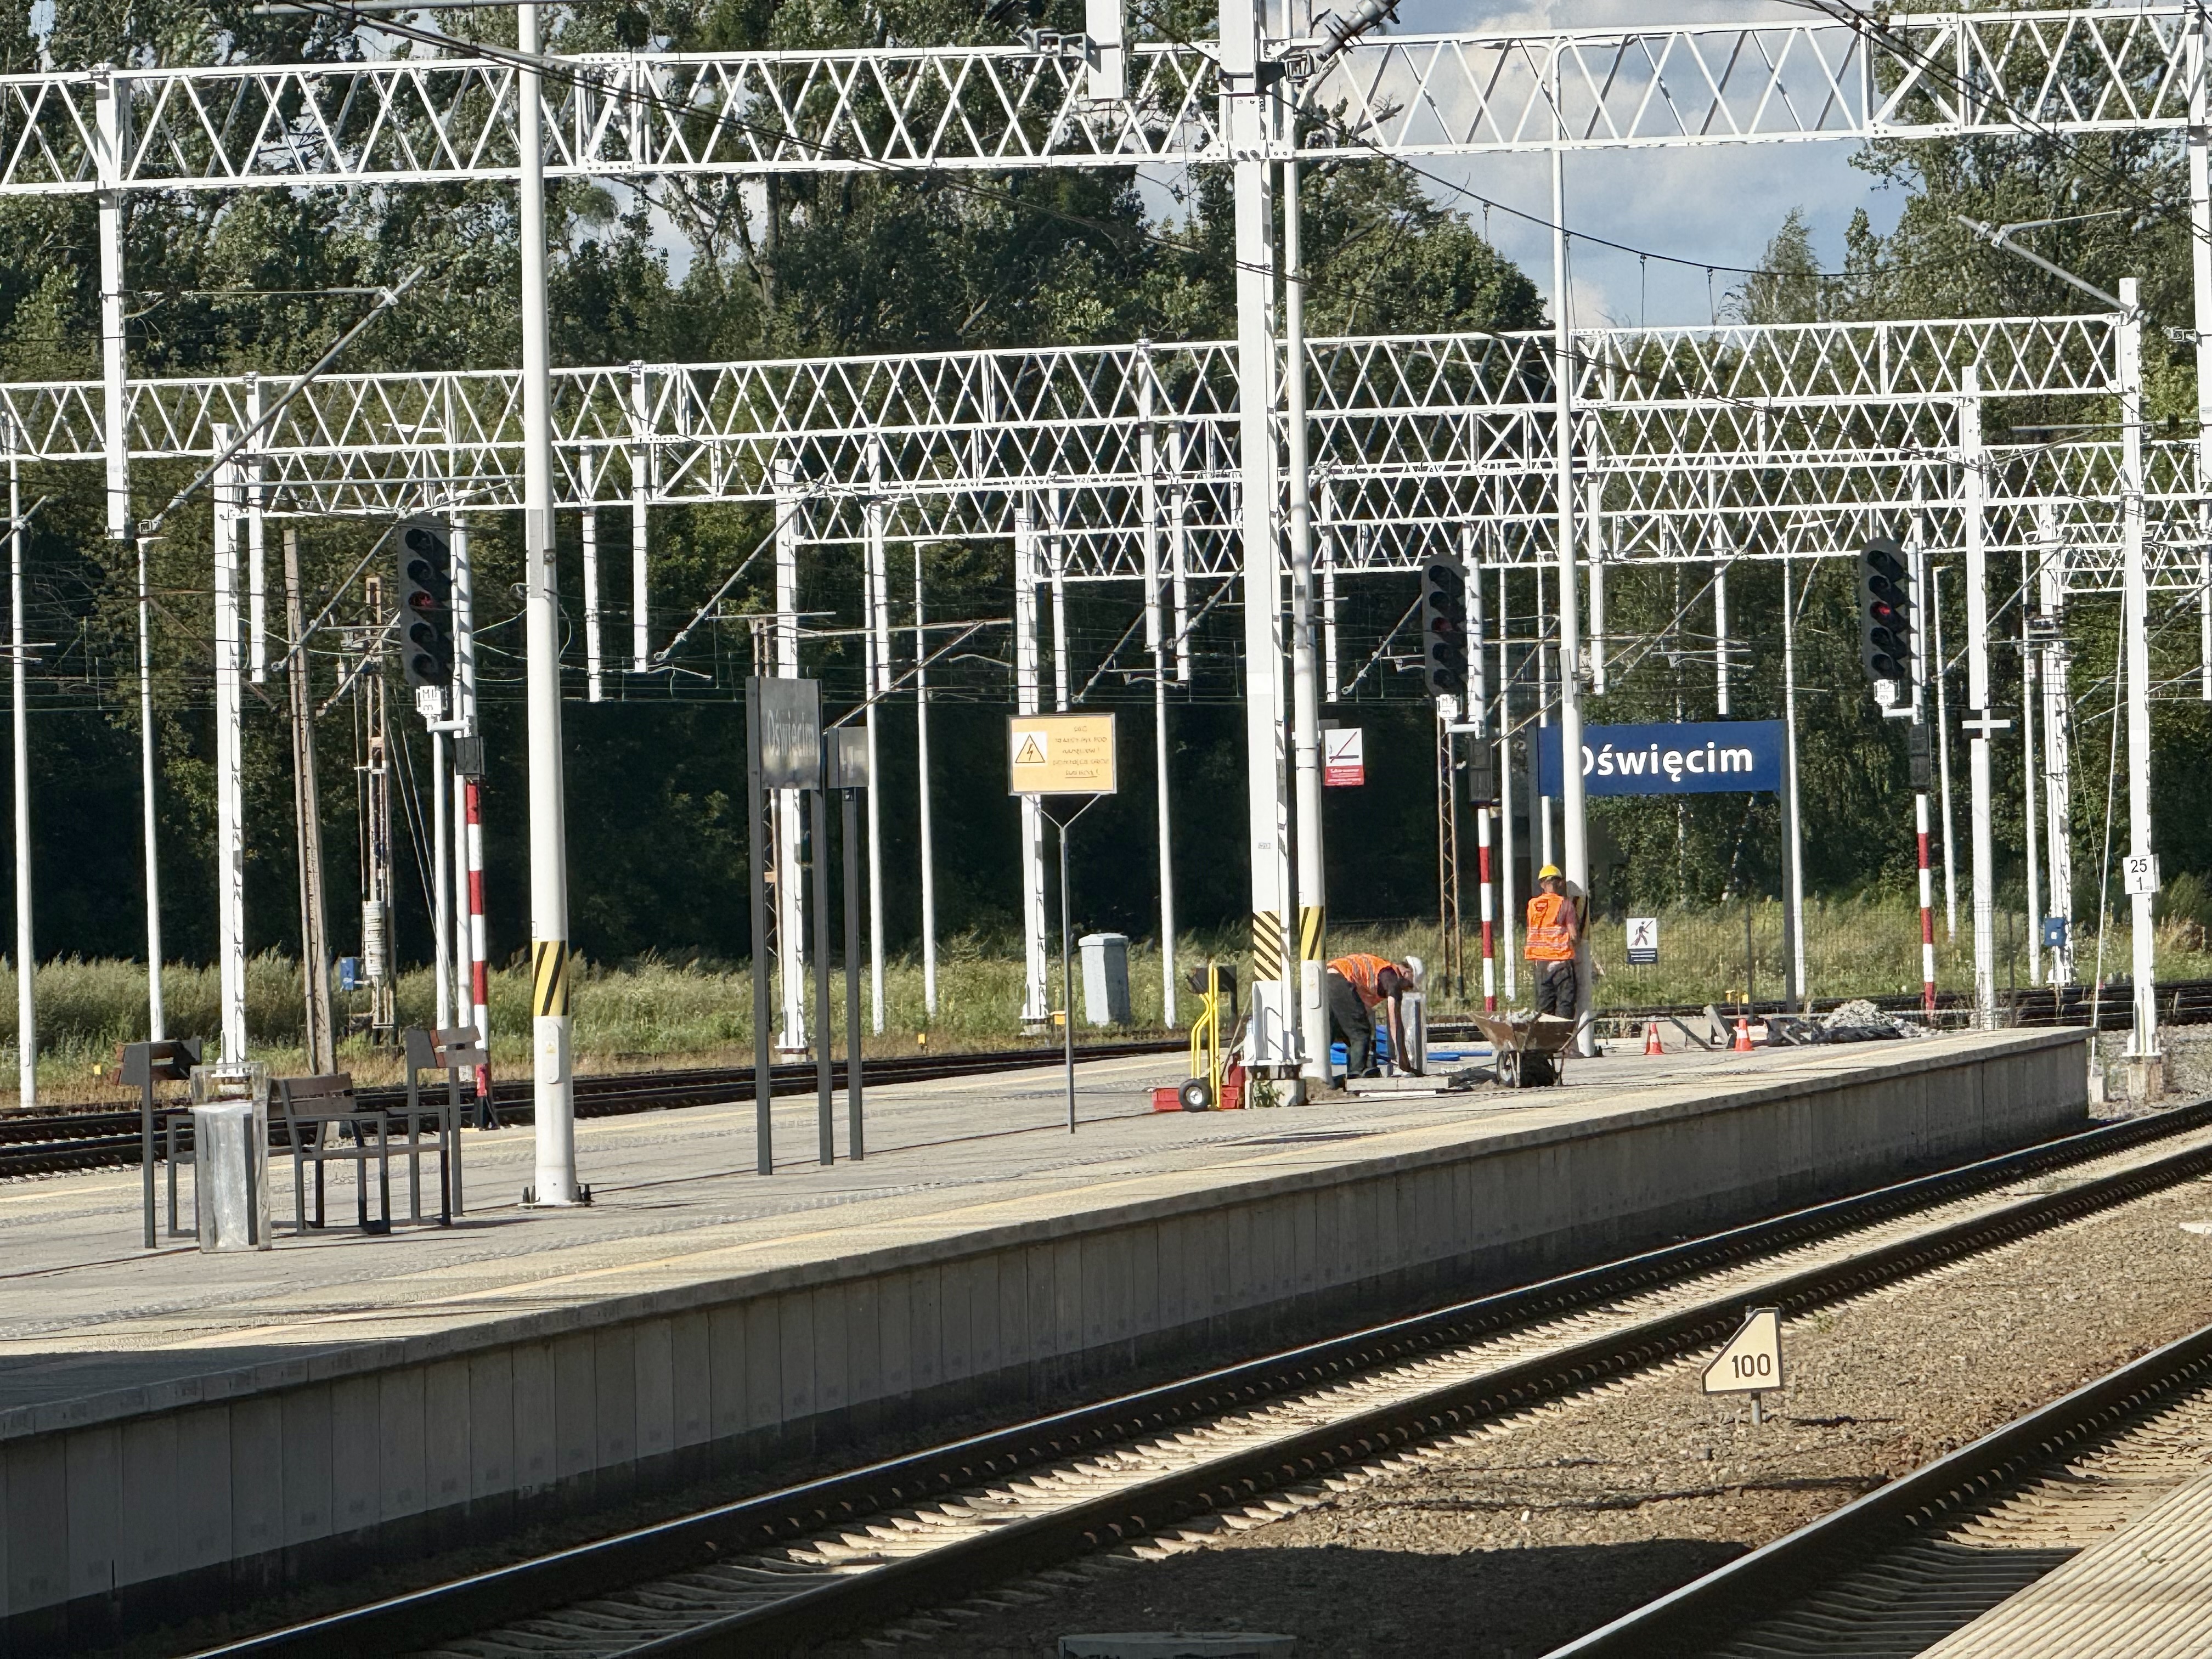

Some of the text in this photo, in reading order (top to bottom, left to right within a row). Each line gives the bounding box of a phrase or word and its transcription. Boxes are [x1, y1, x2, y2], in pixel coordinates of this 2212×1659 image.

[2130, 859, 2147, 873] 25
[2136, 876, 2142, 891] 1
[1731, 1353, 1771, 1378] 100
